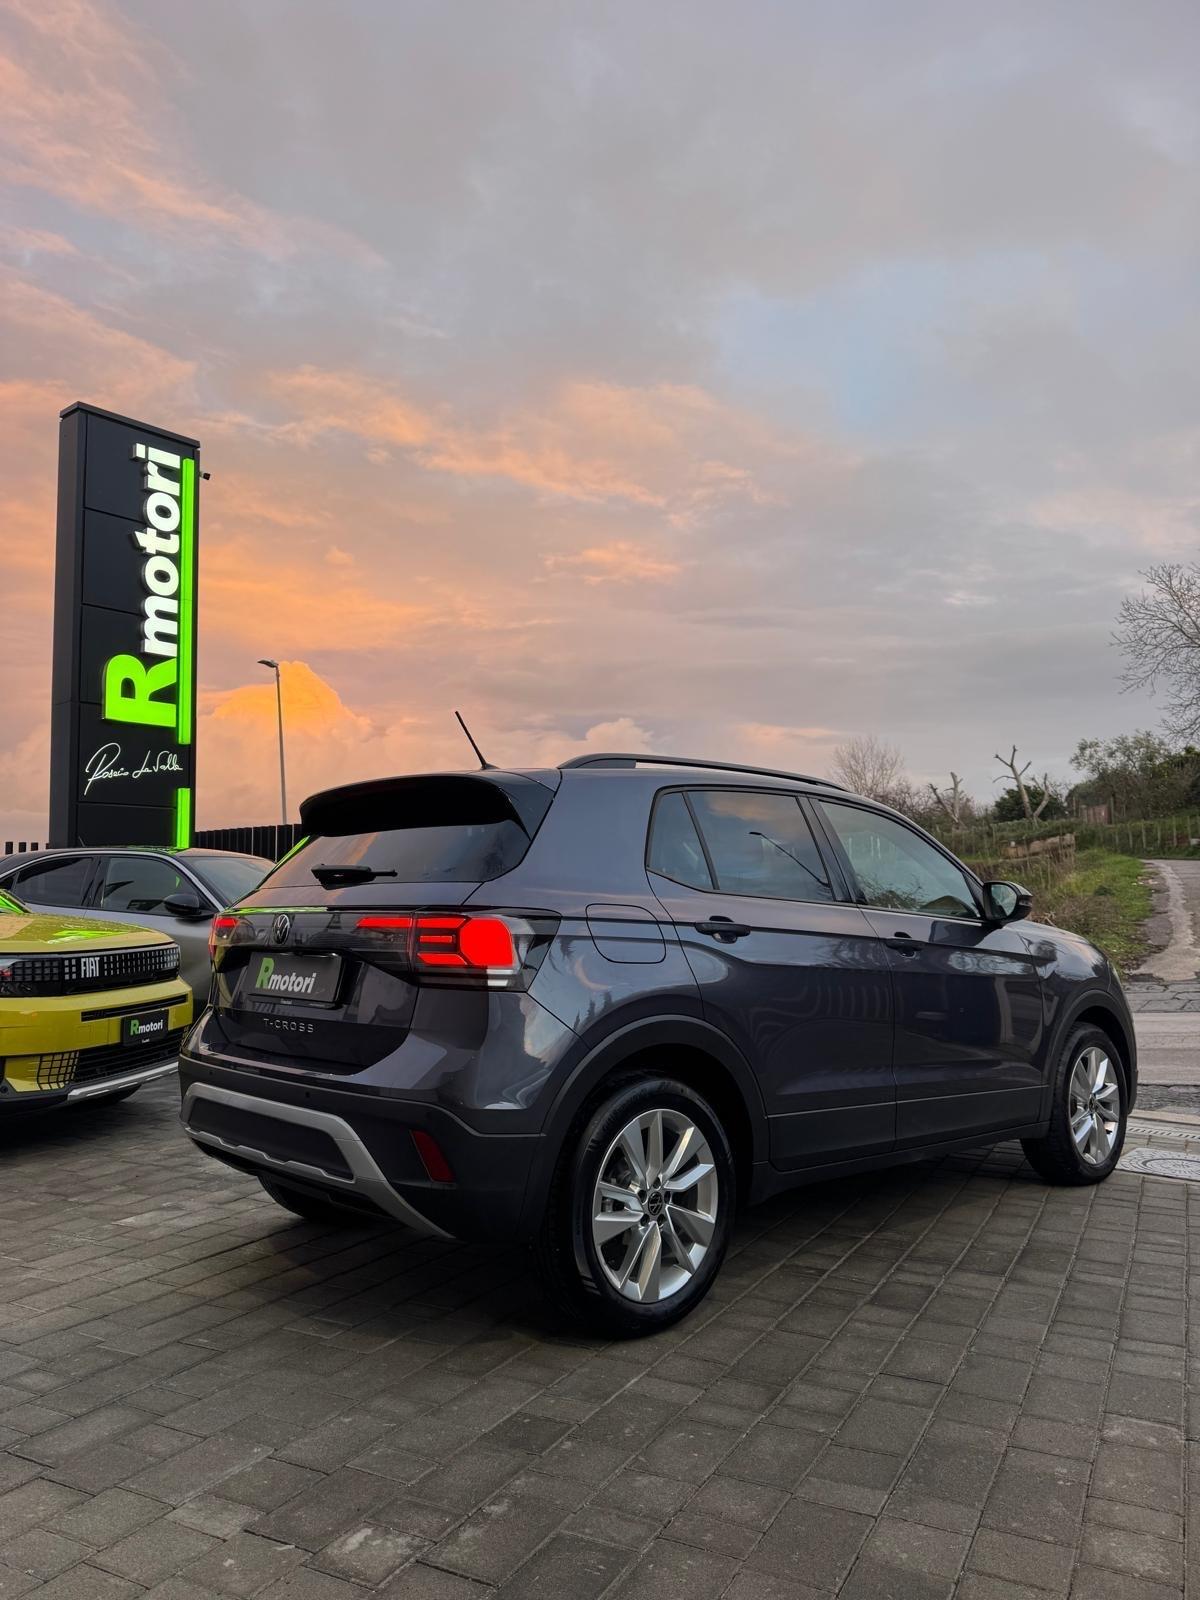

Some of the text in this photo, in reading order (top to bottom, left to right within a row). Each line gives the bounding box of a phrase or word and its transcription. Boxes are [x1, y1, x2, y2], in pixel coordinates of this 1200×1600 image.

[103, 443, 181, 728] Rmotori
[81, 956, 100, 979] FIAT
[256, 957, 317, 995] Rmotori
[130, 1019, 164, 1036] Rmotori
[263, 1018, 314, 1033] T-CROSS
